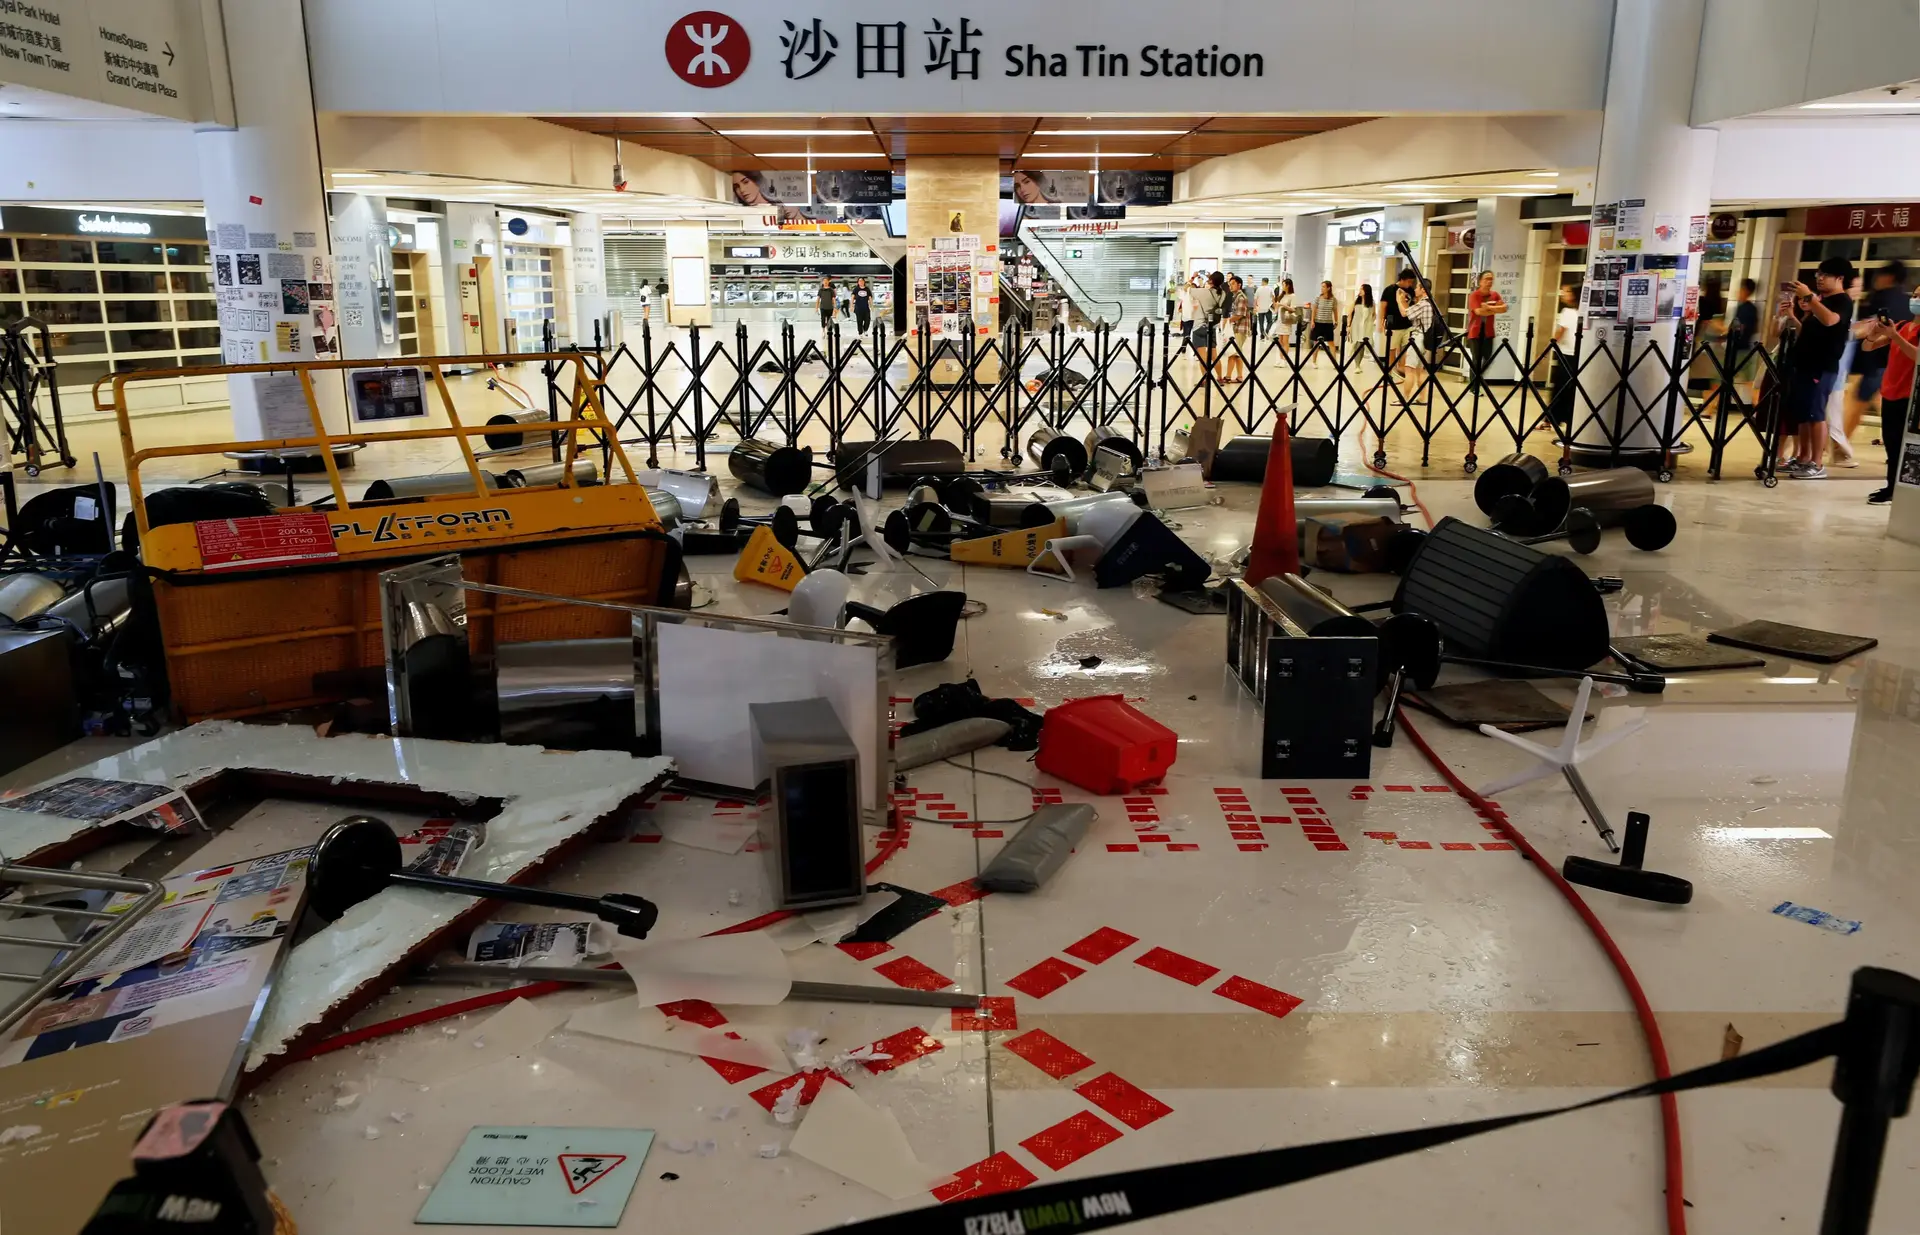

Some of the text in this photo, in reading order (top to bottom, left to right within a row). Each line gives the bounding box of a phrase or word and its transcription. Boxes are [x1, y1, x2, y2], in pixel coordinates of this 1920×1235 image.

[17, 1, 38, 20] Park
[38, 8, 60, 26] Hotel
[99, 26, 148, 53] HomeSquare
[780, 18, 984, 80] 沙田站
[0, 42, 71, 72] New Town Tower
[1005, 44, 1264, 78] Sha Tin Station
[106, 70, 178, 98] Grand Central Plaza
[1848, 207, 1910, 230] 周大福
[782, 245, 820, 259] 沙田站
[822, 250, 869, 258] Sha Tin Statio
[278, 527, 313, 536] 200 Kg
[400, 522, 515, 540] BASKET
[468, 1166, 544, 1175] WET FLOOR
[475, 1156, 549, 1166] 小心地滑
[470, 1176, 531, 1186] CAUTION
[965, 1191, 1132, 1235] New Town Plaza
